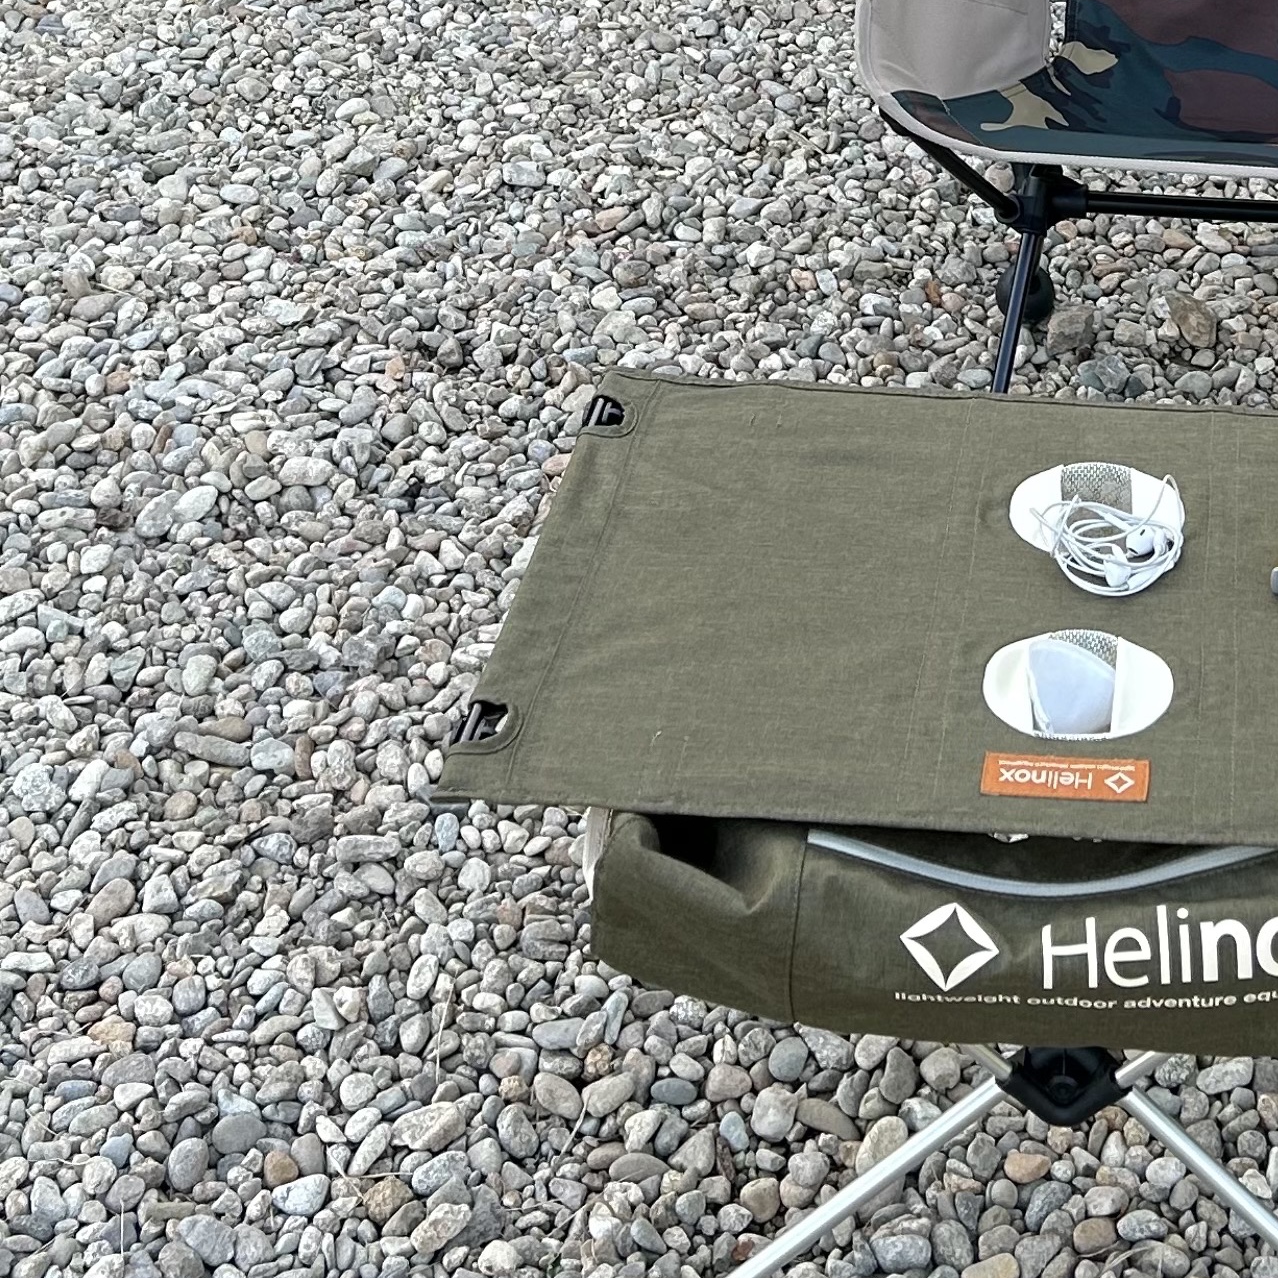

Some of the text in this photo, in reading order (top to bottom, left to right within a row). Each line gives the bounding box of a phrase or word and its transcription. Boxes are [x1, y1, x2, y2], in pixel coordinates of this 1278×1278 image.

[999, 768, 1092, 790] Helinox
[895, 992, 1020, 1005] lightweight
[1027, 995, 1117, 1009] outdoor
[1124, 992, 1236, 1009] adventure
